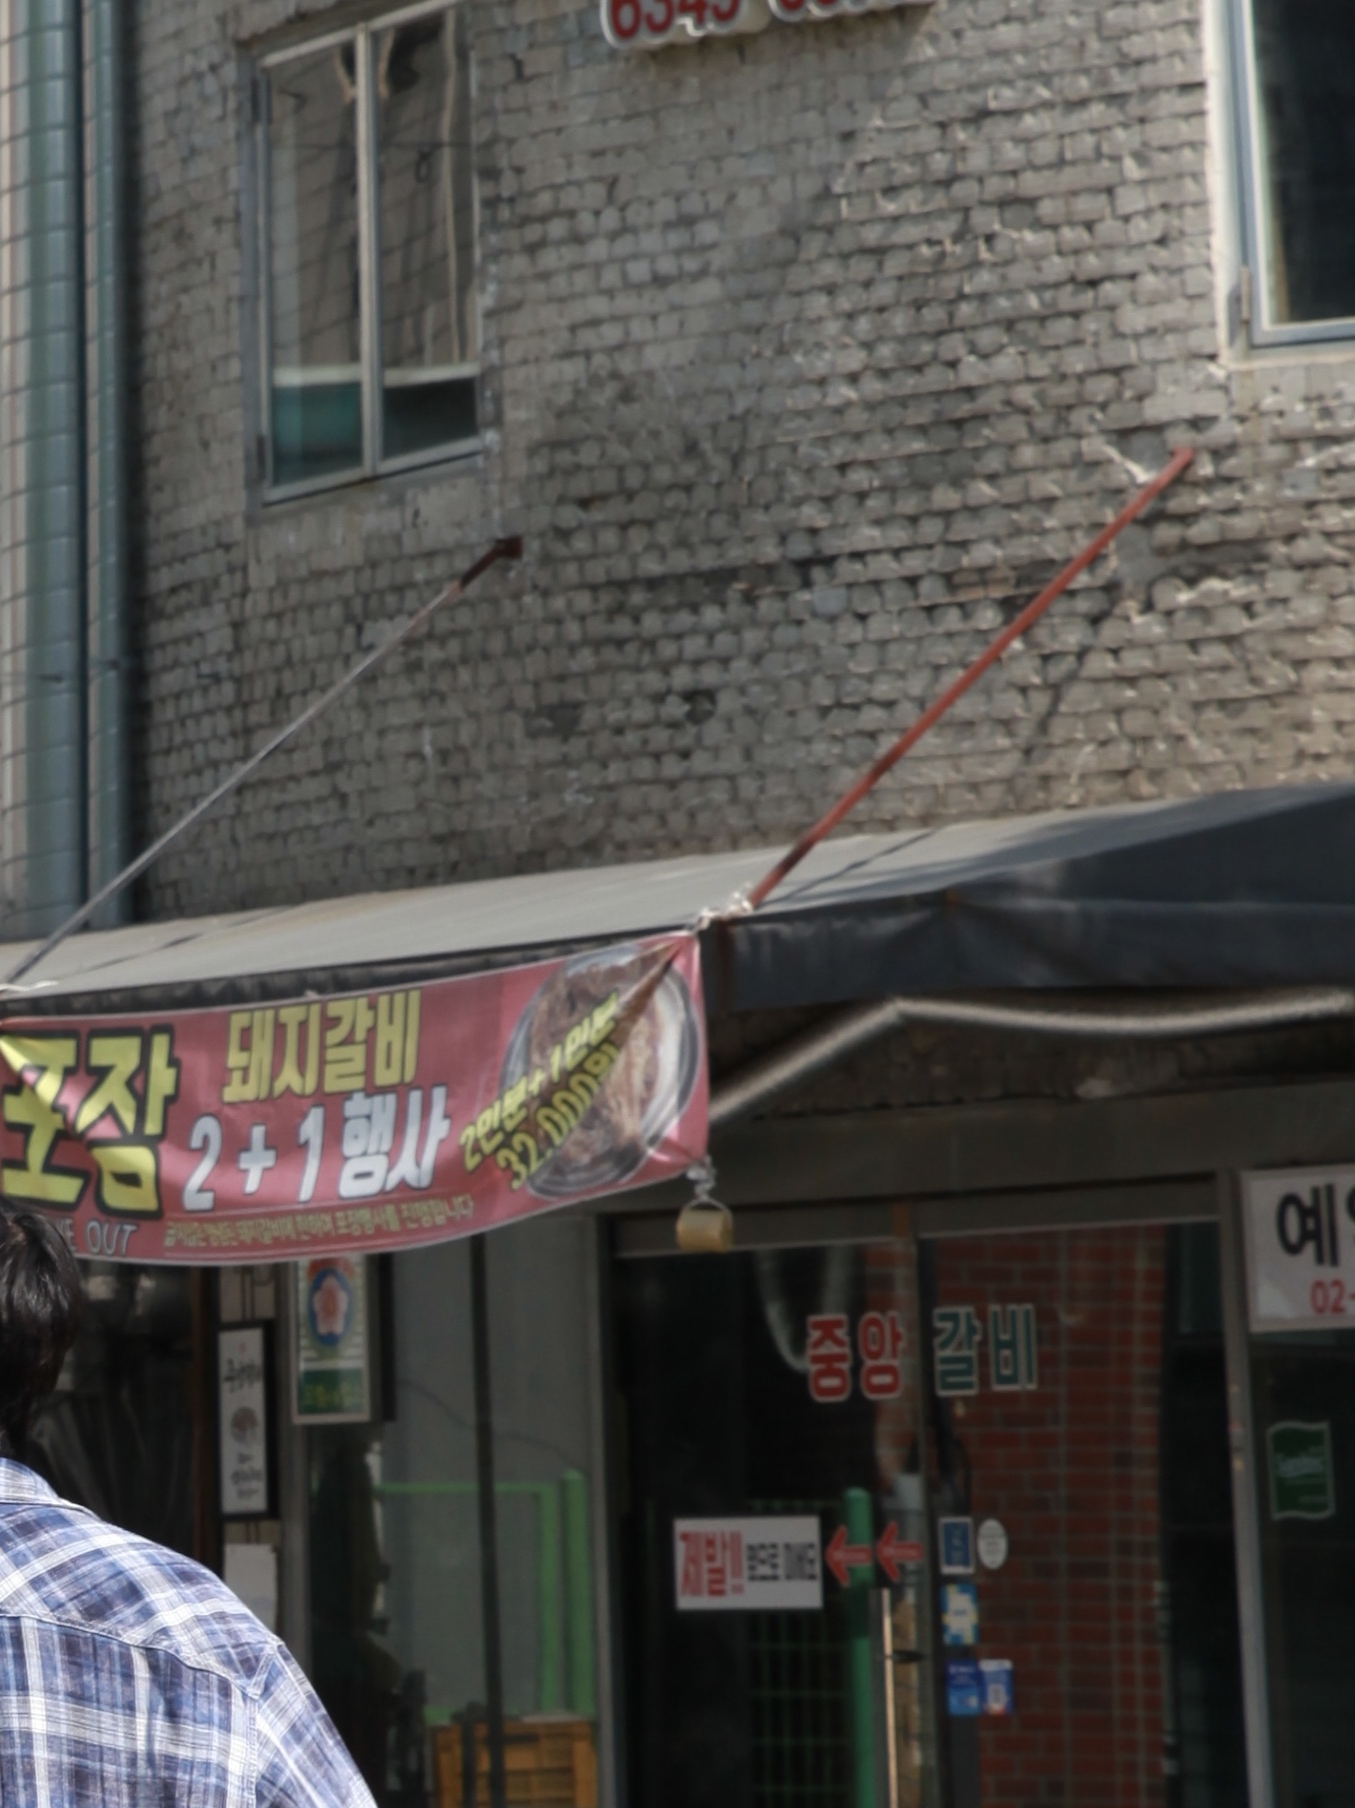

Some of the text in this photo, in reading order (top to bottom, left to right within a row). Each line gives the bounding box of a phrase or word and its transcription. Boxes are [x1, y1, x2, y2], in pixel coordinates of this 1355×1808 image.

[222, 989, 422, 1104] 돼지갈비
[182, 1085, 452, 1212] 2 + 1 행사
[84, 1219, 137, 1256] OUT
[1276, 1182, 1355, 1267] 예
[806, 1303, 1038, 1403] 중앙 갈비
